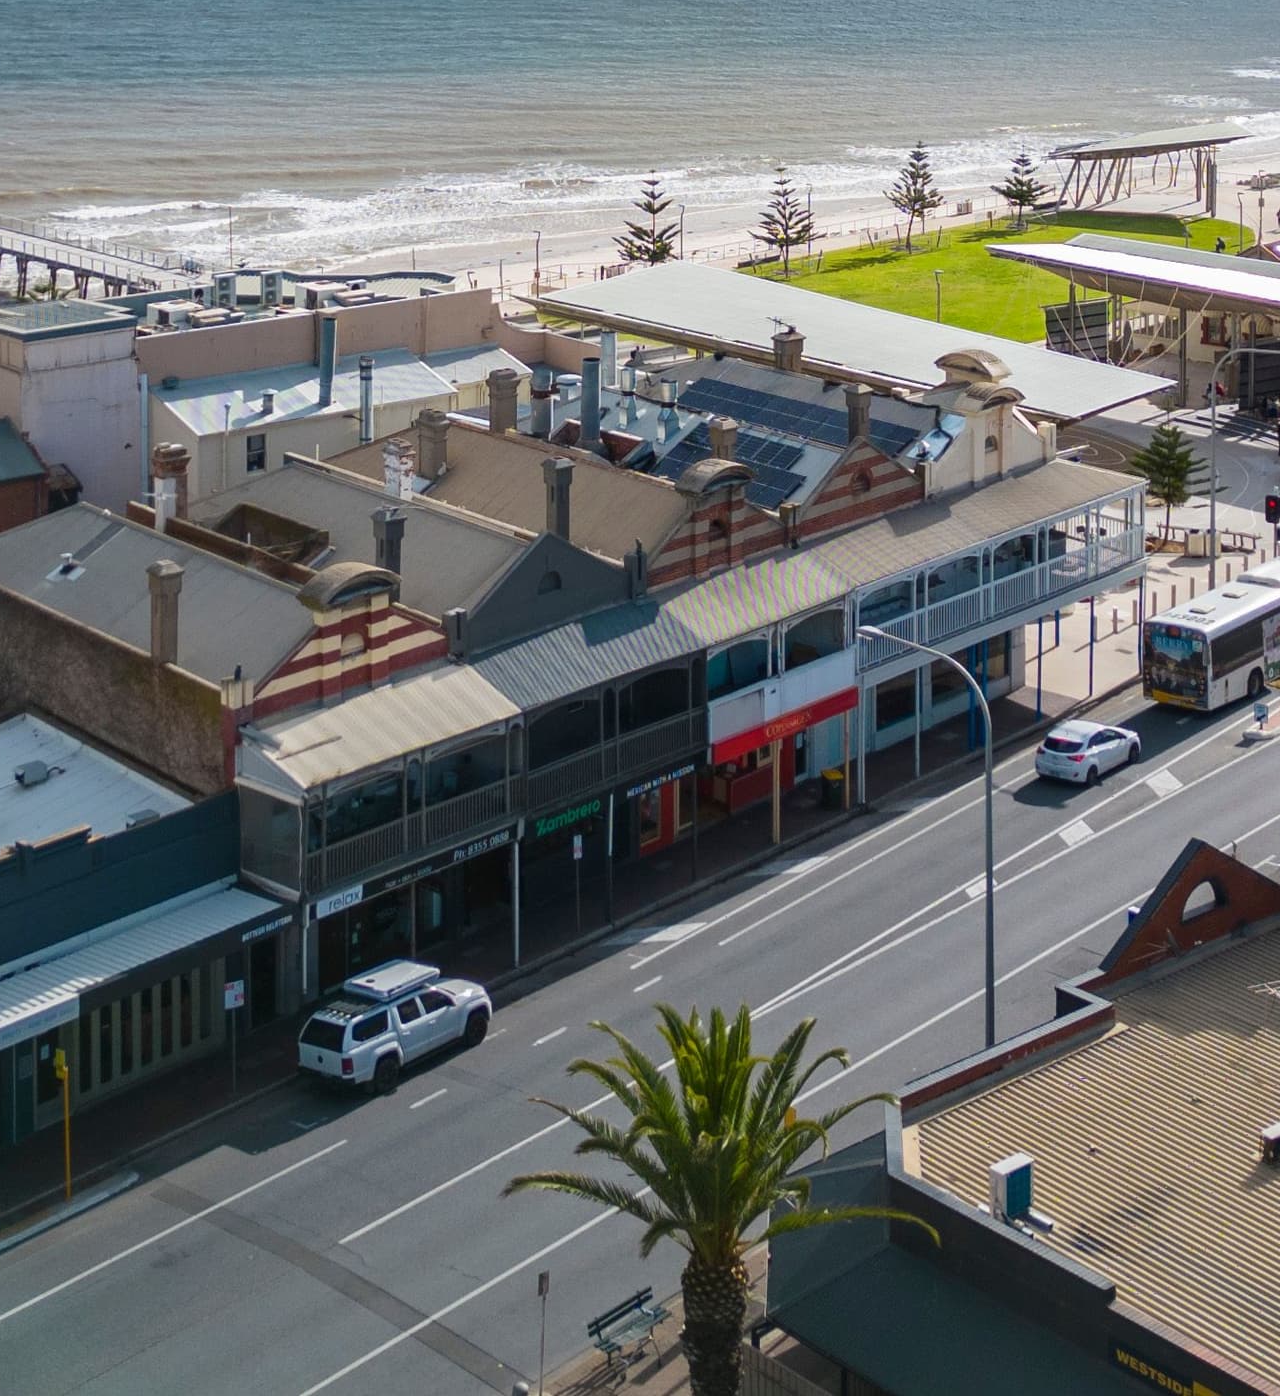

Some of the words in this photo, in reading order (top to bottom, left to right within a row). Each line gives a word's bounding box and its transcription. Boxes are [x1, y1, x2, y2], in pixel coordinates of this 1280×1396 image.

[627, 781, 652, 798] MEXICAN
[328, 889, 361, 913] relax
[1115, 1347, 1193, 1396] WESTSIDE
